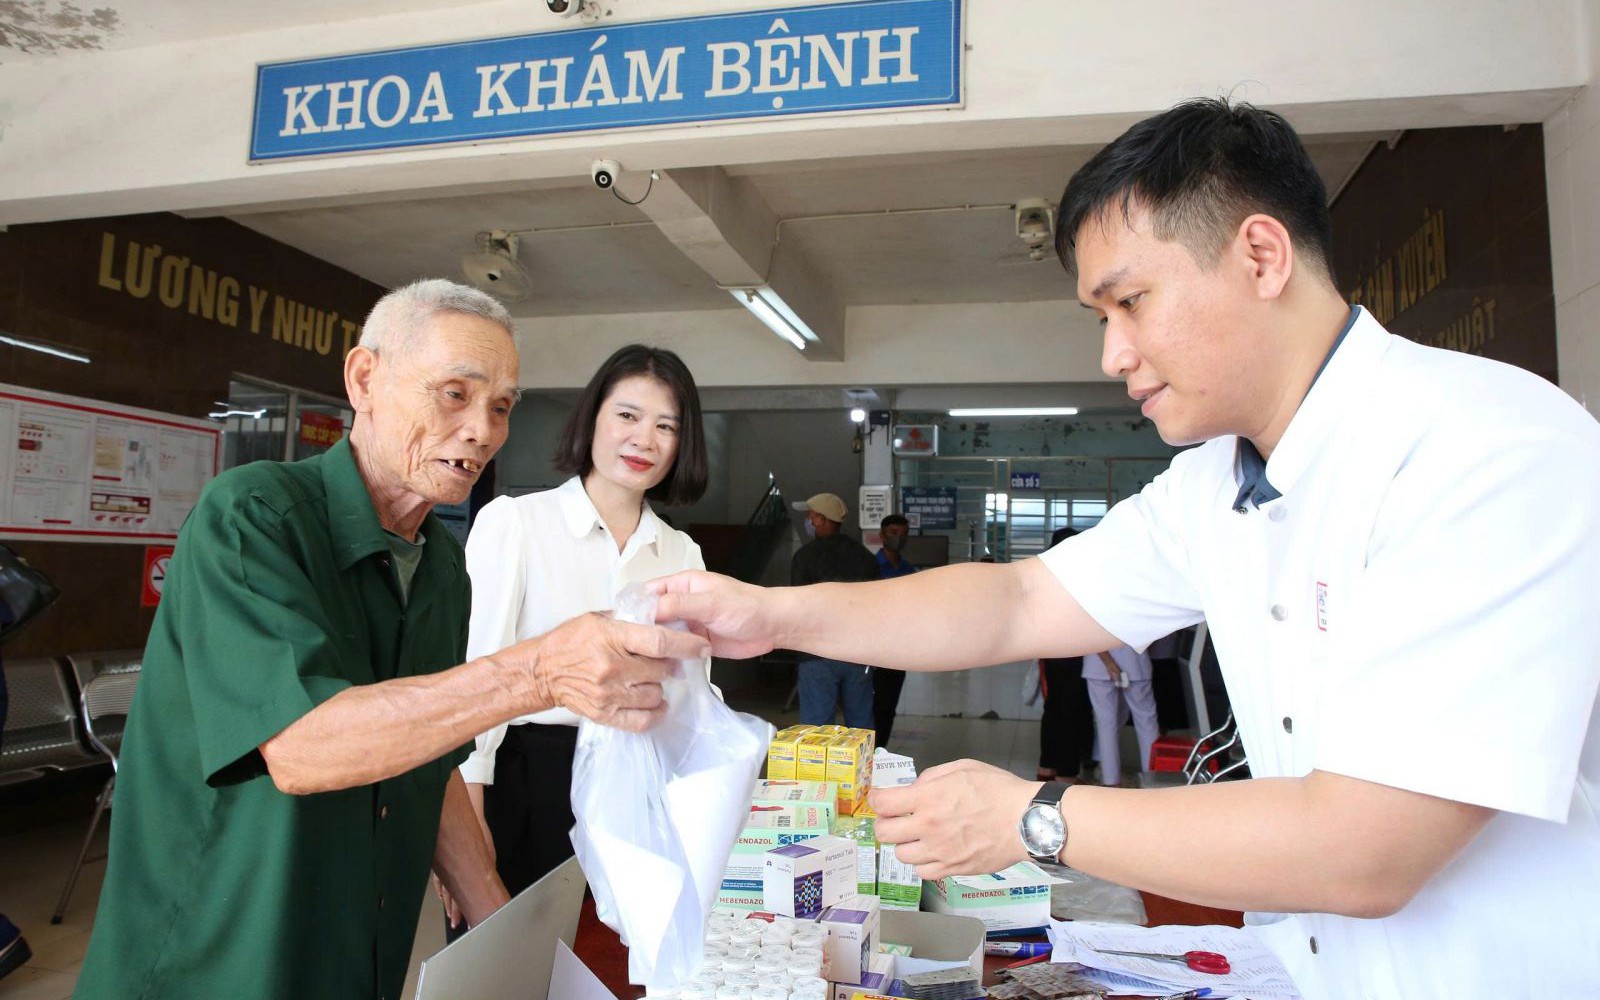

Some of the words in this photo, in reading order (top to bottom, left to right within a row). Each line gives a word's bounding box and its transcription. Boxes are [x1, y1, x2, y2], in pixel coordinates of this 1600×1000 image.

[279, 71, 453, 137] KHOA
[473, 35, 685, 119] KHÁM
[704, 18, 920, 109] BỆNH
[98, 232, 241, 328] LƯƠNG
[249, 286, 269, 334] Y
[272, 295, 338, 355] NHƯ
[720, 897, 764, 905] MEBENDAZO
[961, 890, 1006, 899] MEBENDAZOL
